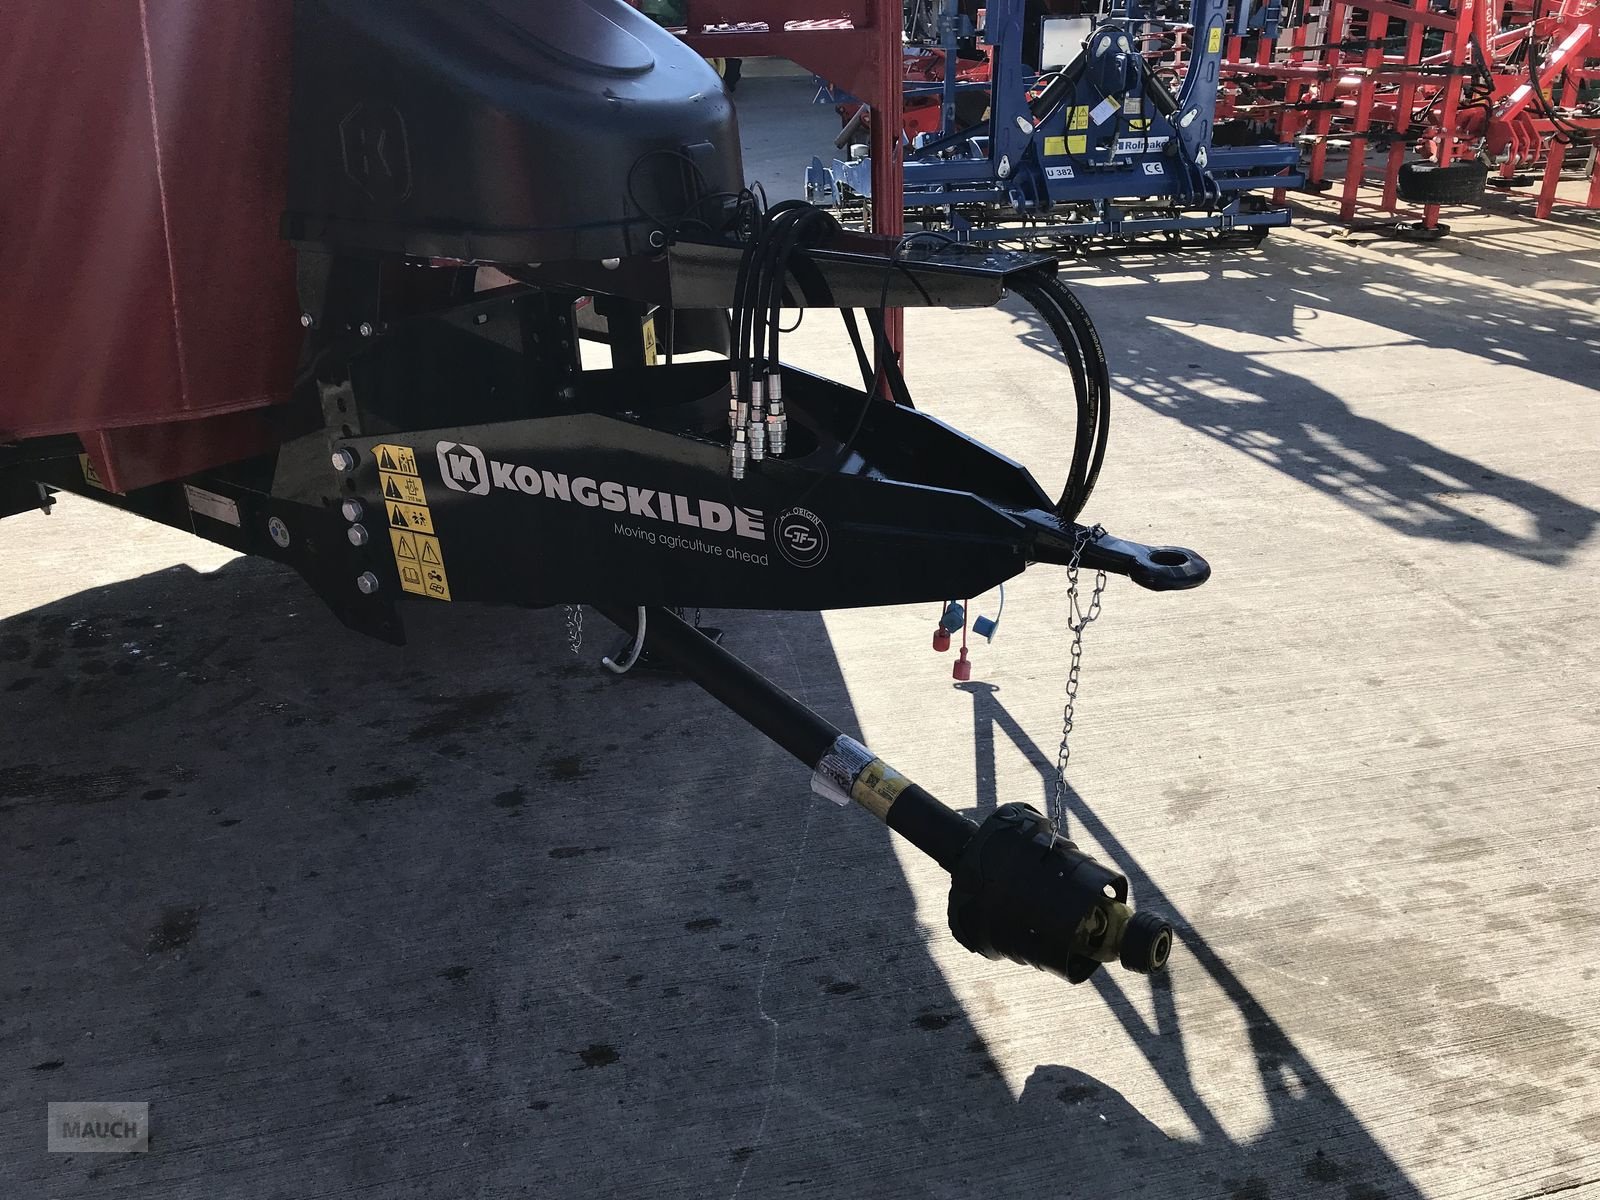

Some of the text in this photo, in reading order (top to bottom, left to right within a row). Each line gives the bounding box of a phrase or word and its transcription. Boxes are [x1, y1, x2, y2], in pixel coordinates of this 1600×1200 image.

[1145, 163, 1162, 174] CE
[490, 460, 765, 541] KONGSKILDE
[792, 506, 821, 526] ORIGIN
[614, 523, 769, 566] Moving agriculture ahead
